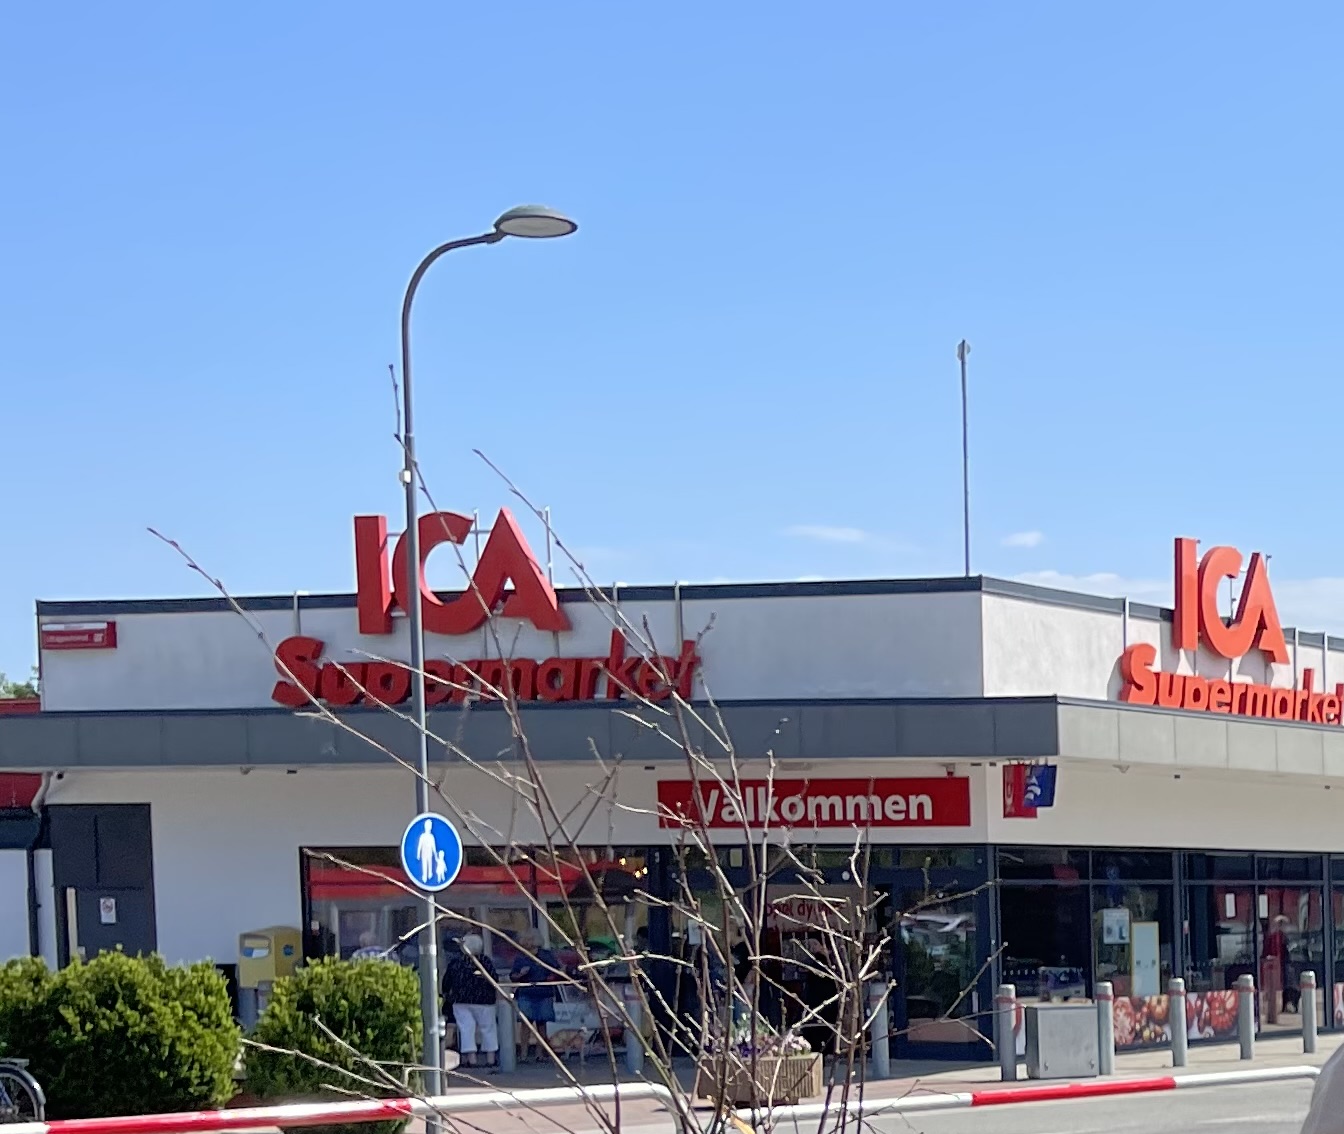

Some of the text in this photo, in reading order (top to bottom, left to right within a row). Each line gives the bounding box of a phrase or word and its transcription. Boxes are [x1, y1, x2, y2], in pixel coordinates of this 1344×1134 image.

[353, 506, 573, 634] ICA
[1174, 536, 1290, 665] ICA
[271, 628, 700, 707] Supermarket
[699, 786, 933, 823] Välkommen
